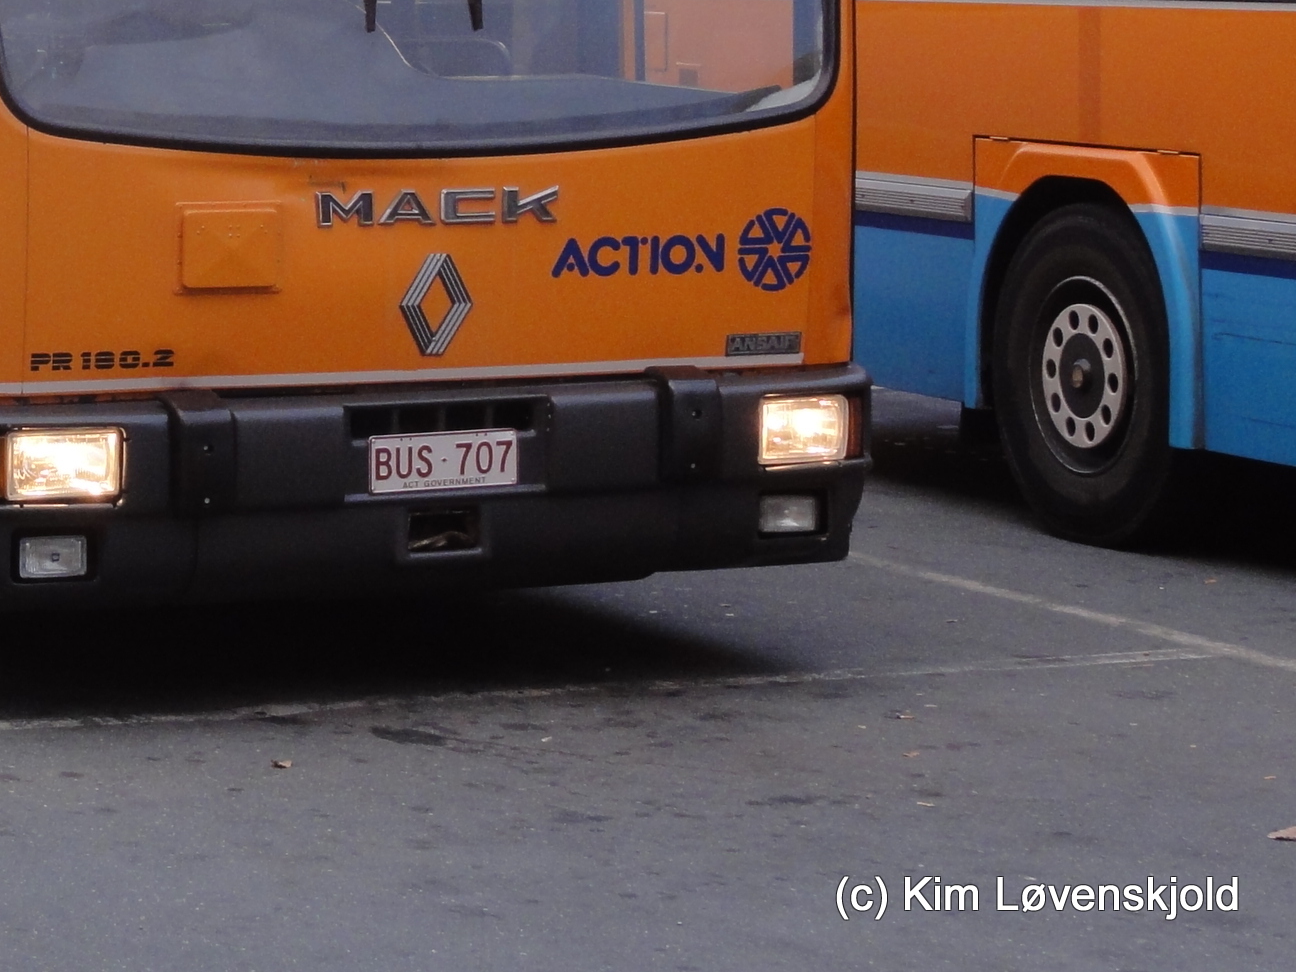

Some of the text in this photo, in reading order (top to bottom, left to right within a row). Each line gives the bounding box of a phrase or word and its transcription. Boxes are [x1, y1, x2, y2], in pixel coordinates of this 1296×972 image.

[315, 185, 559, 228] MACK
[552, 234, 725, 278] ACTION
[30, 349, 175, 372] PR 180.2
[375, 440, 513, 481] BUS 707
[403, 477, 486, 488] ACT GOVERNMENT
